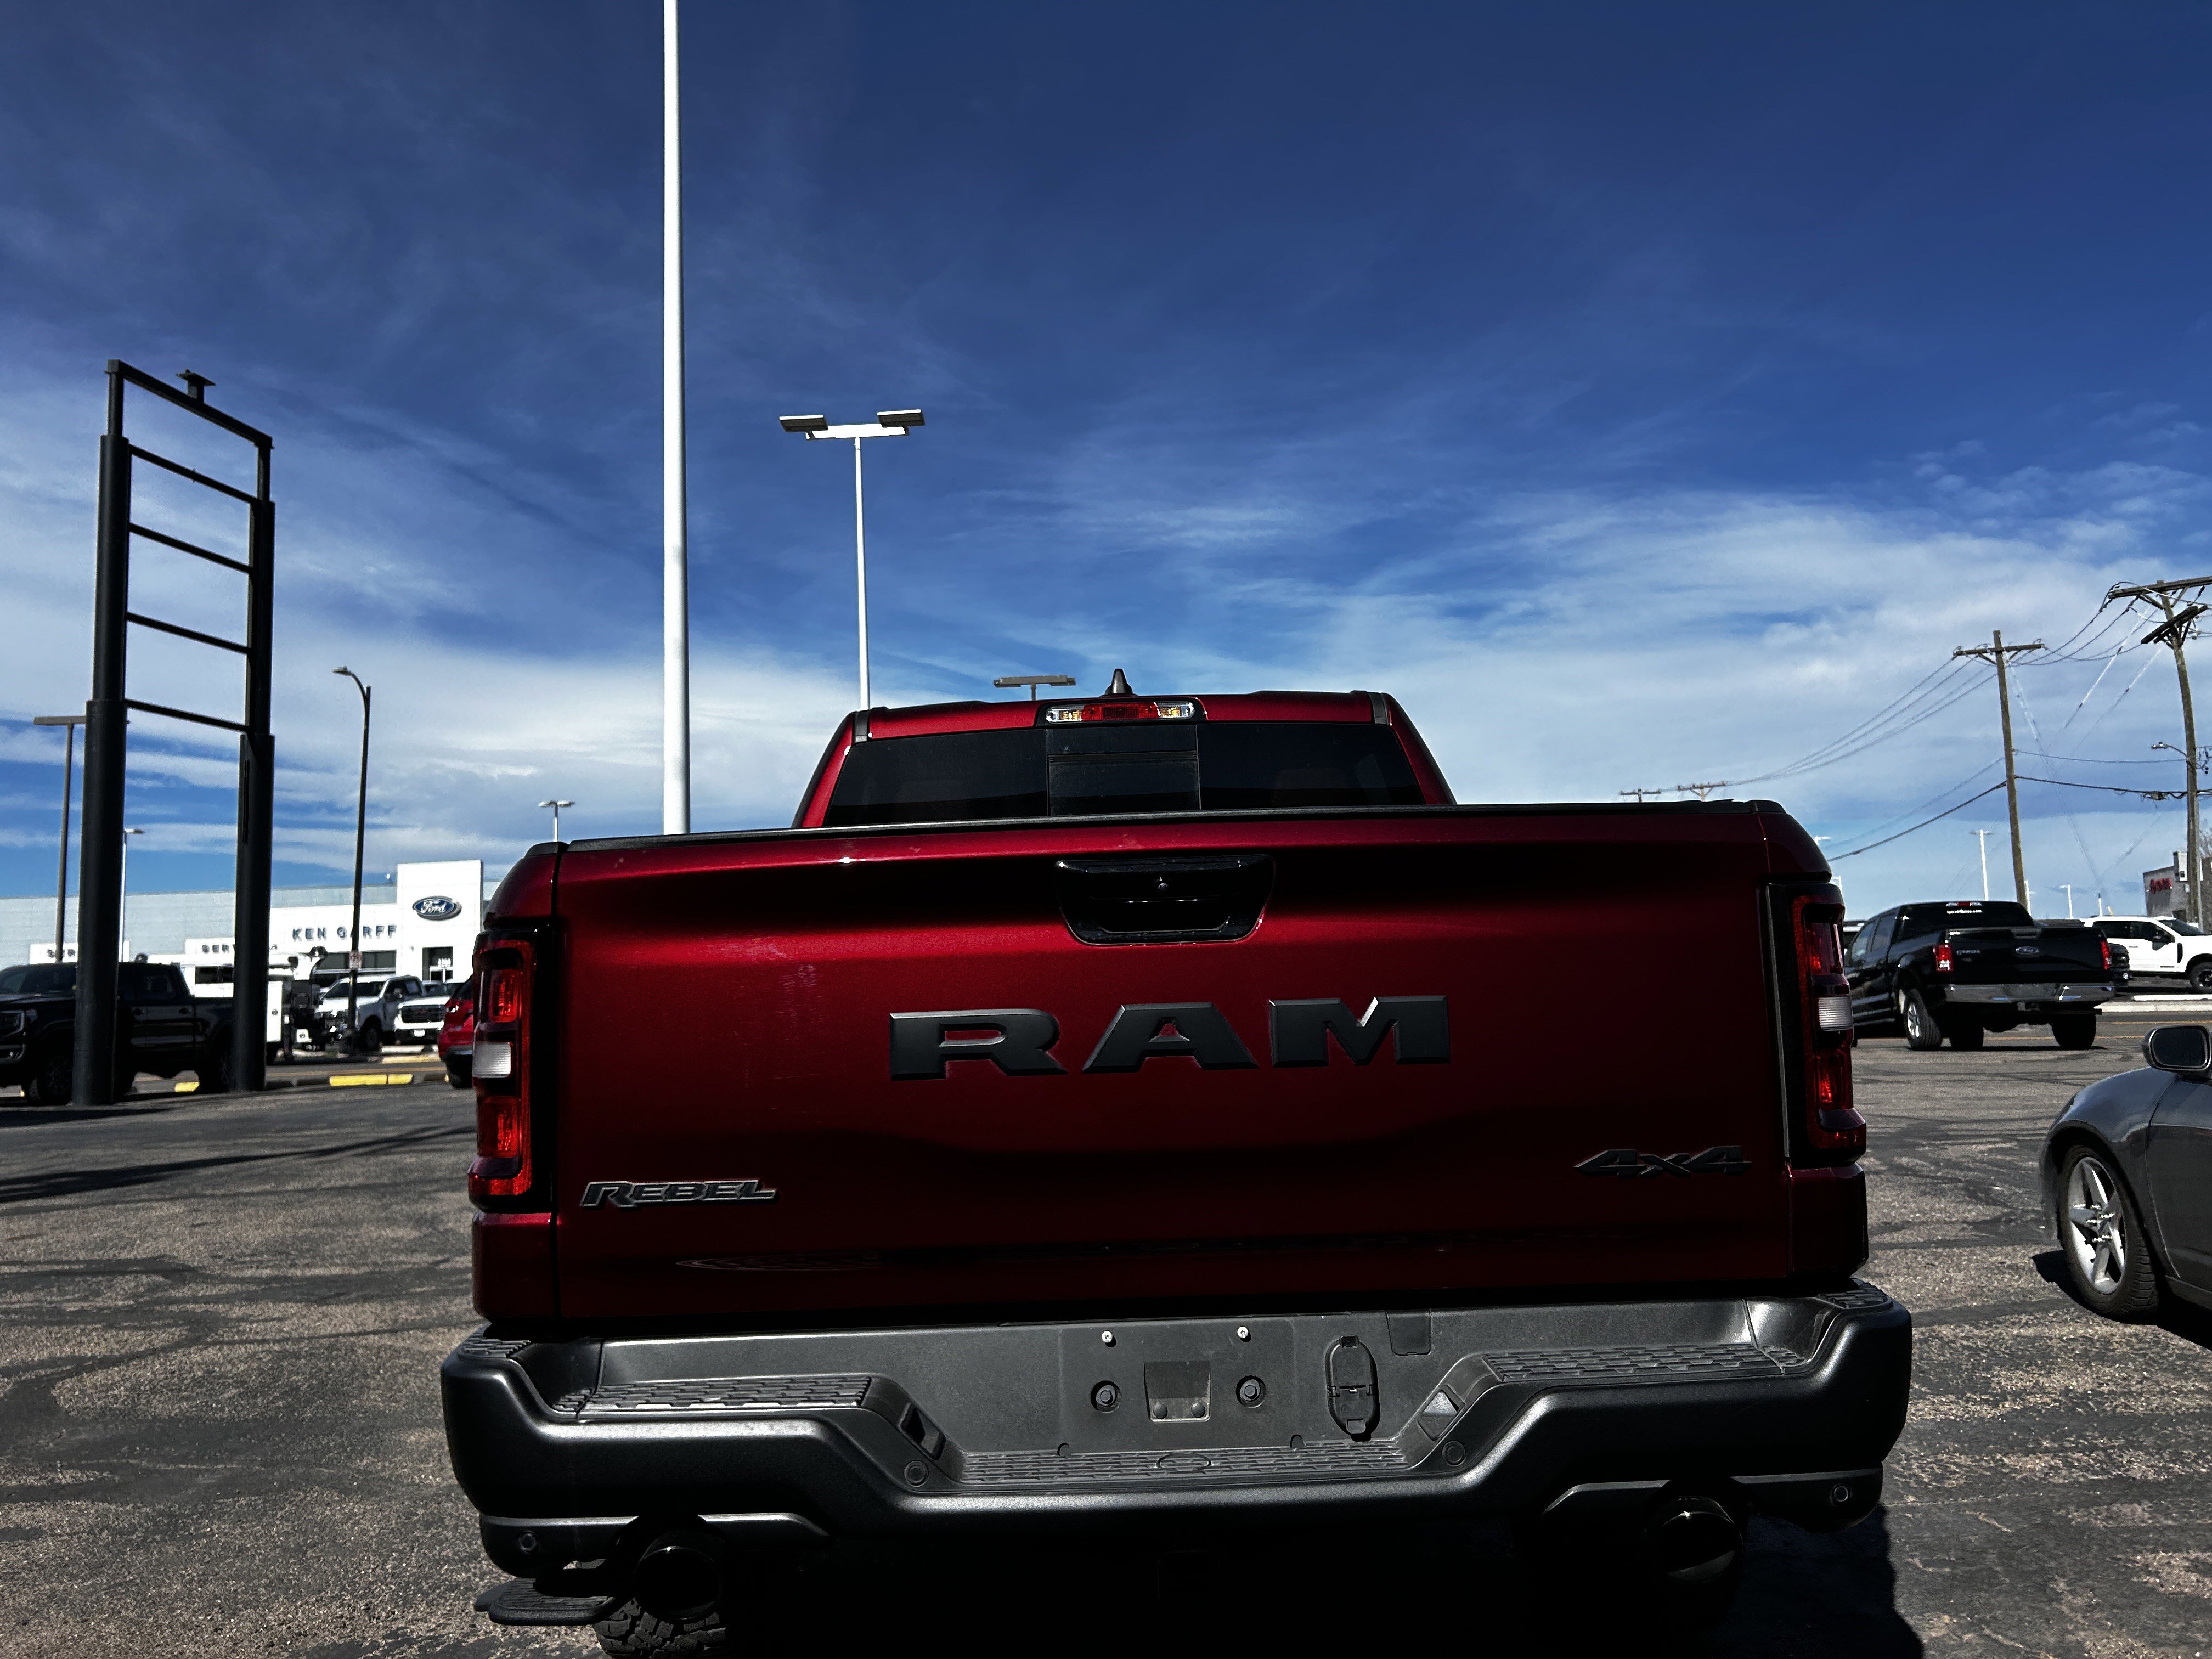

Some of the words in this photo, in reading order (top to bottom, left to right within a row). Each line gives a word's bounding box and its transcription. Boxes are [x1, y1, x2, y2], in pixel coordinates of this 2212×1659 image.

[420, 900, 446, 913] Ford
[292, 926, 327, 941] KEN
[337, 924, 397, 939] GRFF
[889, 995, 1452, 1081] RAM
[580, 1180, 776, 1207] REBEL
